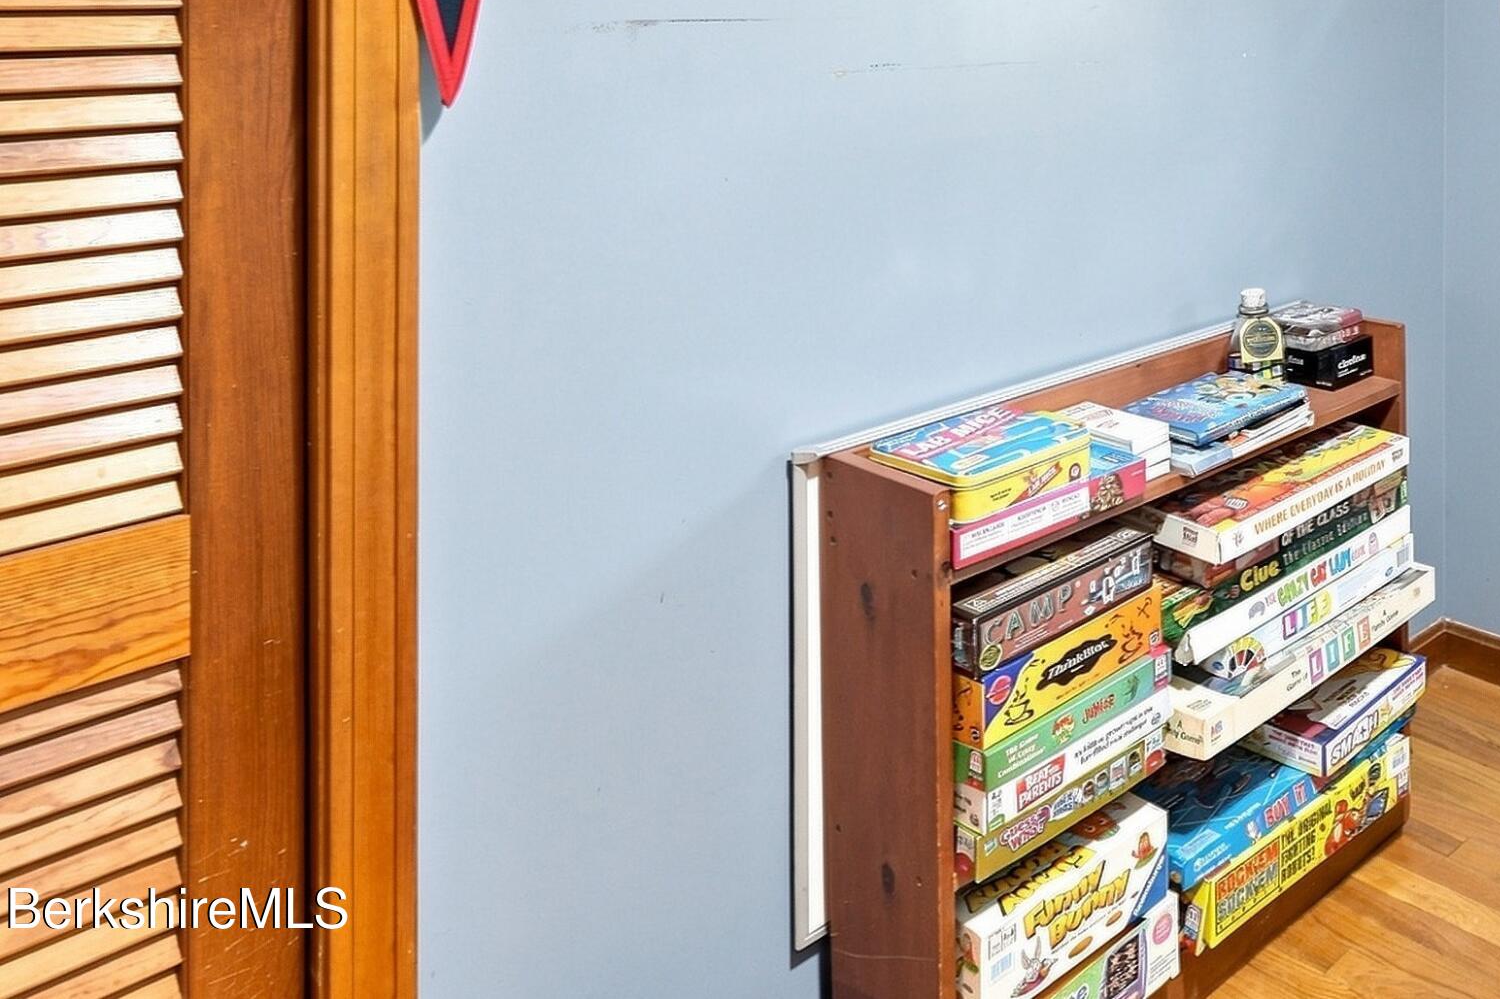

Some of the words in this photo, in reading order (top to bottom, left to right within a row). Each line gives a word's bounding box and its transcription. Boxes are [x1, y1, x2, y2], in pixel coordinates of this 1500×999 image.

[899, 436, 952, 456] LAB
[950, 407, 1013, 437] MICE
[1253, 504, 1290, 535] WHERE
[1290, 482, 1338, 518] EVERYDAY
[1344, 477, 1352, 490] A
[1351, 458, 1387, 486] HOLIDAY
[1281, 532, 1297, 547] OF
[1295, 519, 1315, 542] THE
[1316, 500, 1350, 526] CLASS
[1240, 558, 1281, 592] Clue
[1310, 561, 1328, 587] CAT
[1329, 548, 1351, 576] LADY
[984, 583, 1073, 645] CAMP
[1048, 639, 1114, 682] ThinkBlot
[1308, 615, 1372, 684] LIFE
[1177, 720, 1183, 729] A
[1019, 771, 1063, 812] PARENTS
[1264, 796, 1291, 829] BUY
[1280, 830, 1317, 868] FIGHTING
[1281, 830, 1295, 850] THE
[1049, 868, 1131, 949] BUNNY
